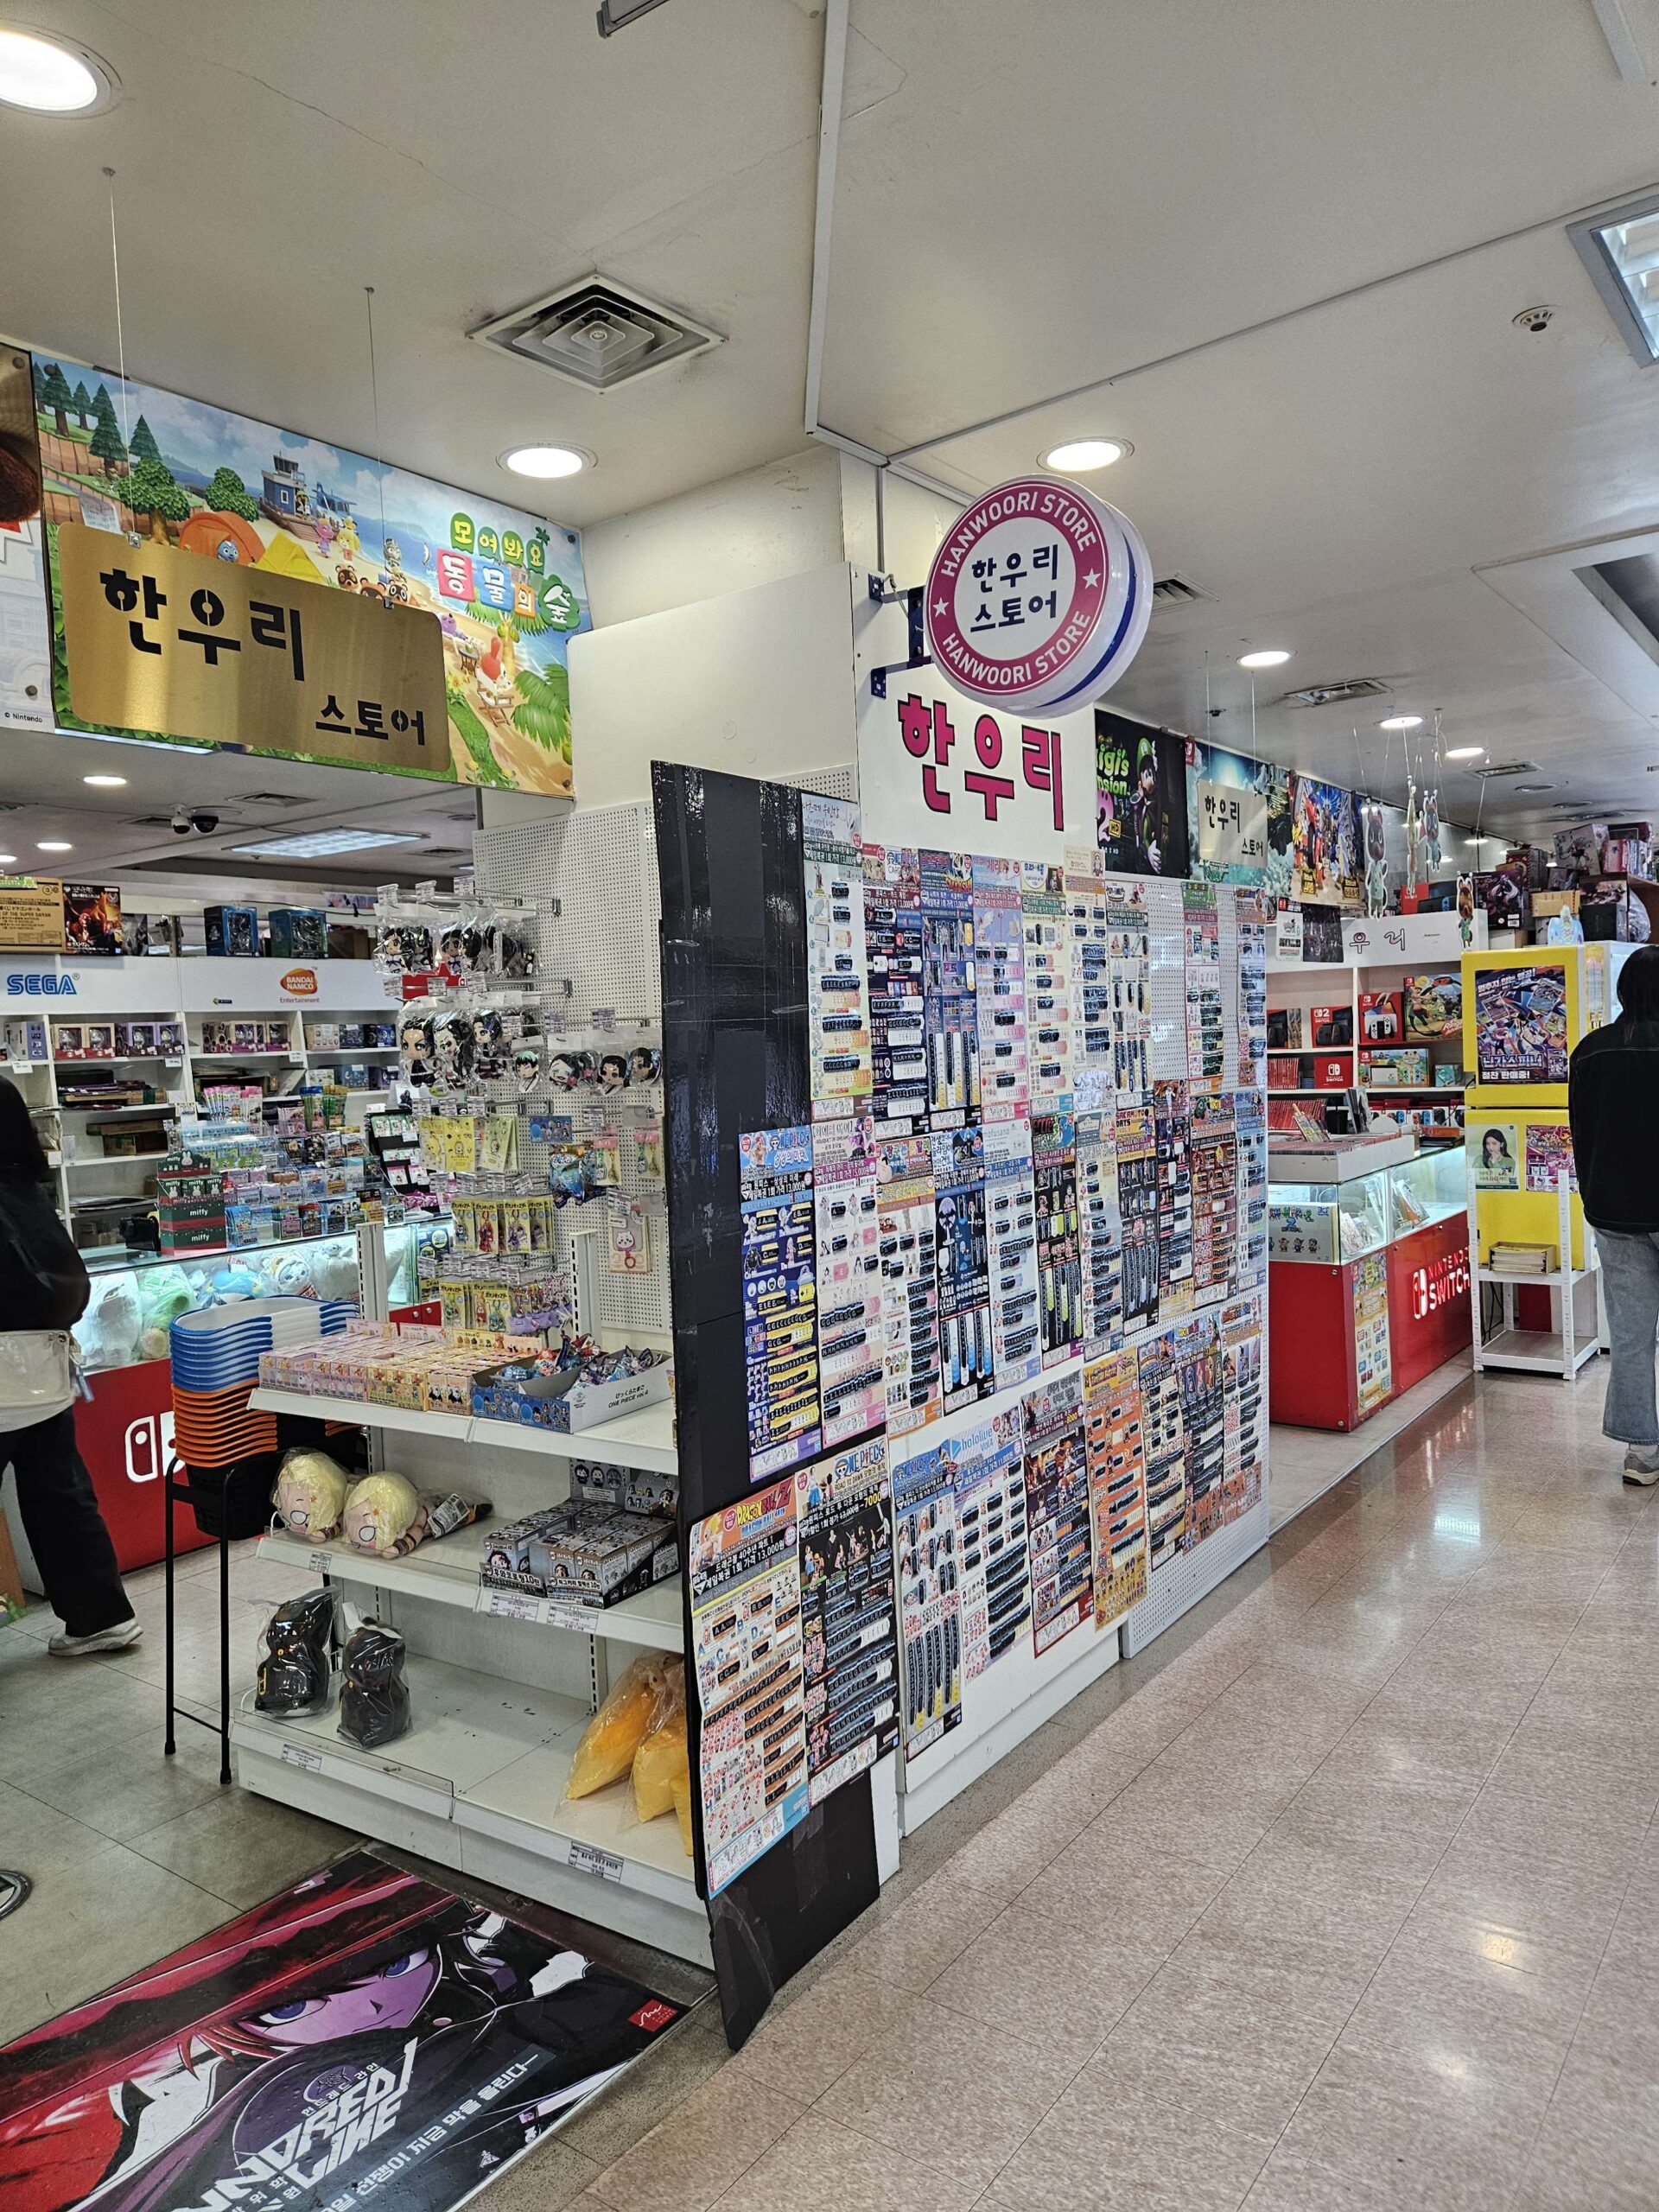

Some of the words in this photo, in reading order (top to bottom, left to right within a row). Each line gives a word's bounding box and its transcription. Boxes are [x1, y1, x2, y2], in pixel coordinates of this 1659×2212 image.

[454, 520, 543, 567] 모여봐요
[941, 492, 1038, 577] HANWOORI
[1040, 493, 1097, 552] STORE
[971, 544, 1058, 593] 한우리
[442, 555, 531, 613] 동물의
[543, 585, 571, 624] 숲
[99, 569, 305, 682] 한우리
[969, 590, 1057, 632] 스토어
[942, 632, 1031, 684] HANWOORI
[1035, 611, 1090, 675] STORE
[13, 713, 43, 723] Nintendo
[315, 695, 425, 747] 스토어
[898, 692, 1064, 832] 한우리
[1110, 823, 1120, 833] HD
[1205, 795, 1240, 833] 한우리
[1242, 838, 1263, 856] 스토어
[7, 975, 77, 995] SEGA
[1323, 1008, 1329, 1017] 2
[190, 1208, 208, 1217] miffy
[1429, 1266, 1470, 1310] SWITCH
[615, 1384, 645, 1399] びっくらたまご
[620, 1395, 636, 1404] PIECE
[962, 1427, 993, 1451] hololive
[864, 1492, 882, 1508] 7000
[715, 1555, 738, 1573] 드래곤볼
[739, 1546, 757, 1560] 40주년
[733, 1563, 742, 1573] 1회
[743, 1555, 756, 1568] 가격
[354, 2153, 411, 2196] 전쟁이
[407, 2126, 447, 2155] 지금
[442, 2099, 482, 2127] 막을
